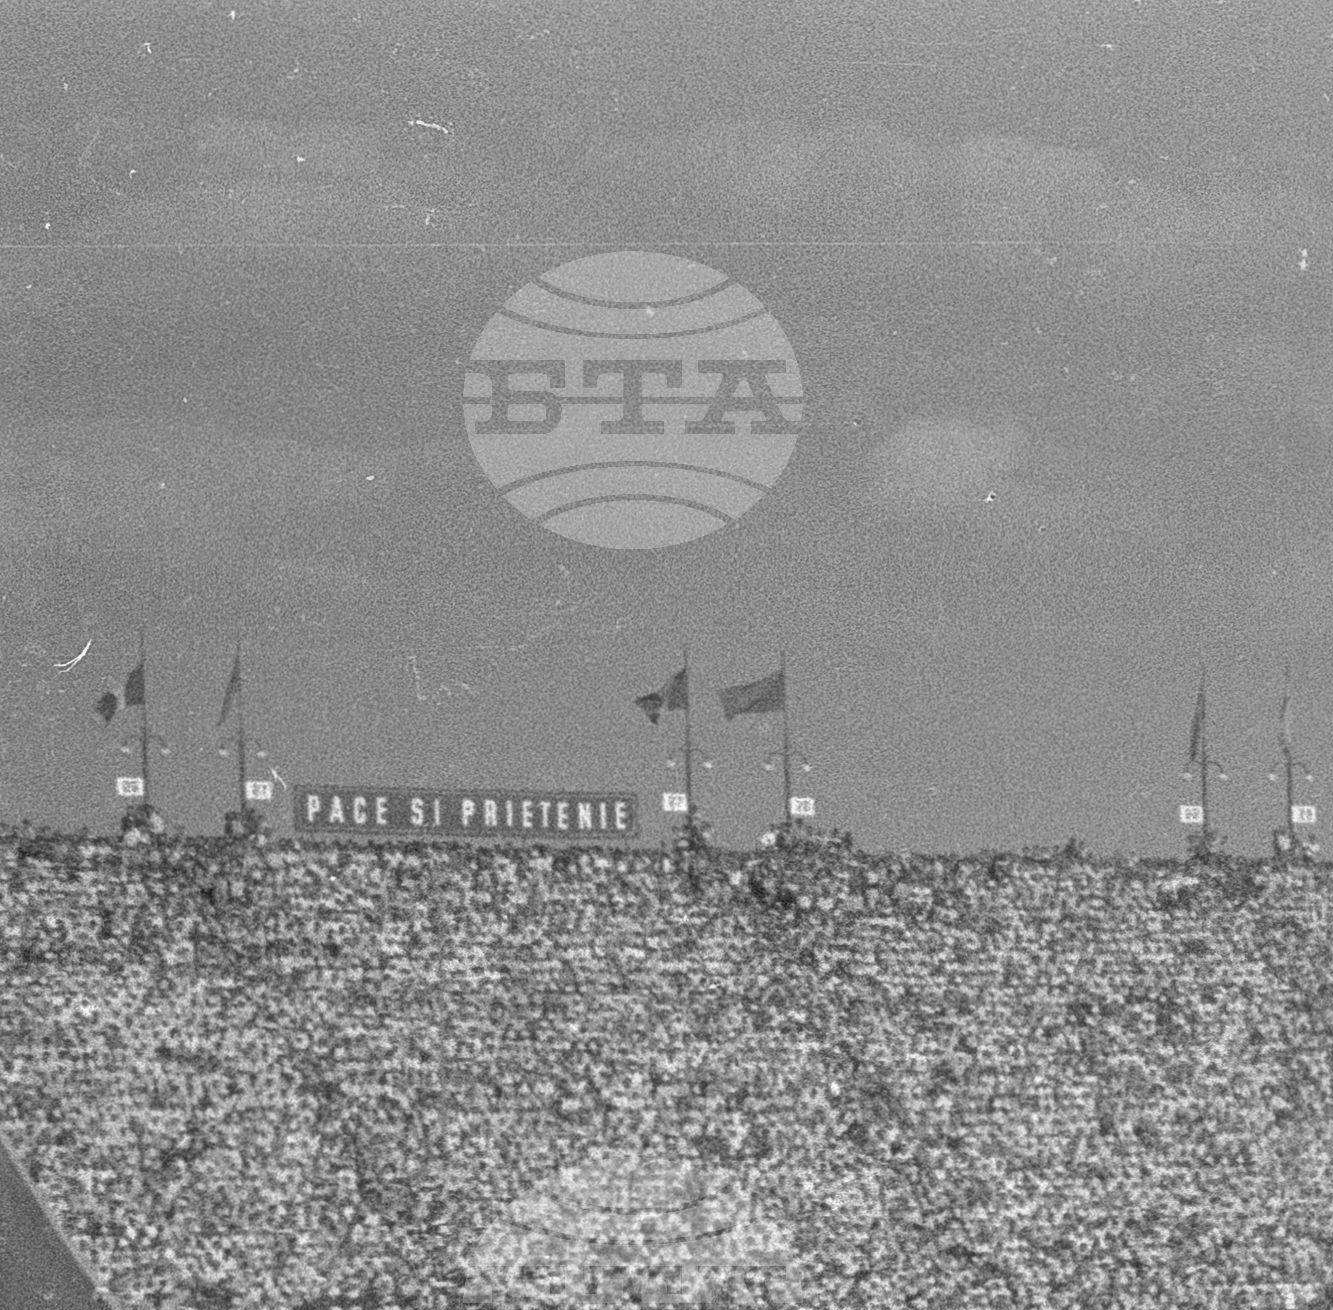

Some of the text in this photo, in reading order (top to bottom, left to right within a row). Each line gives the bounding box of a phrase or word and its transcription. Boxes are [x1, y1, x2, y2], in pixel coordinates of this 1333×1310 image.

[307, 795, 627, 831] PACE SI PRIETENIE
